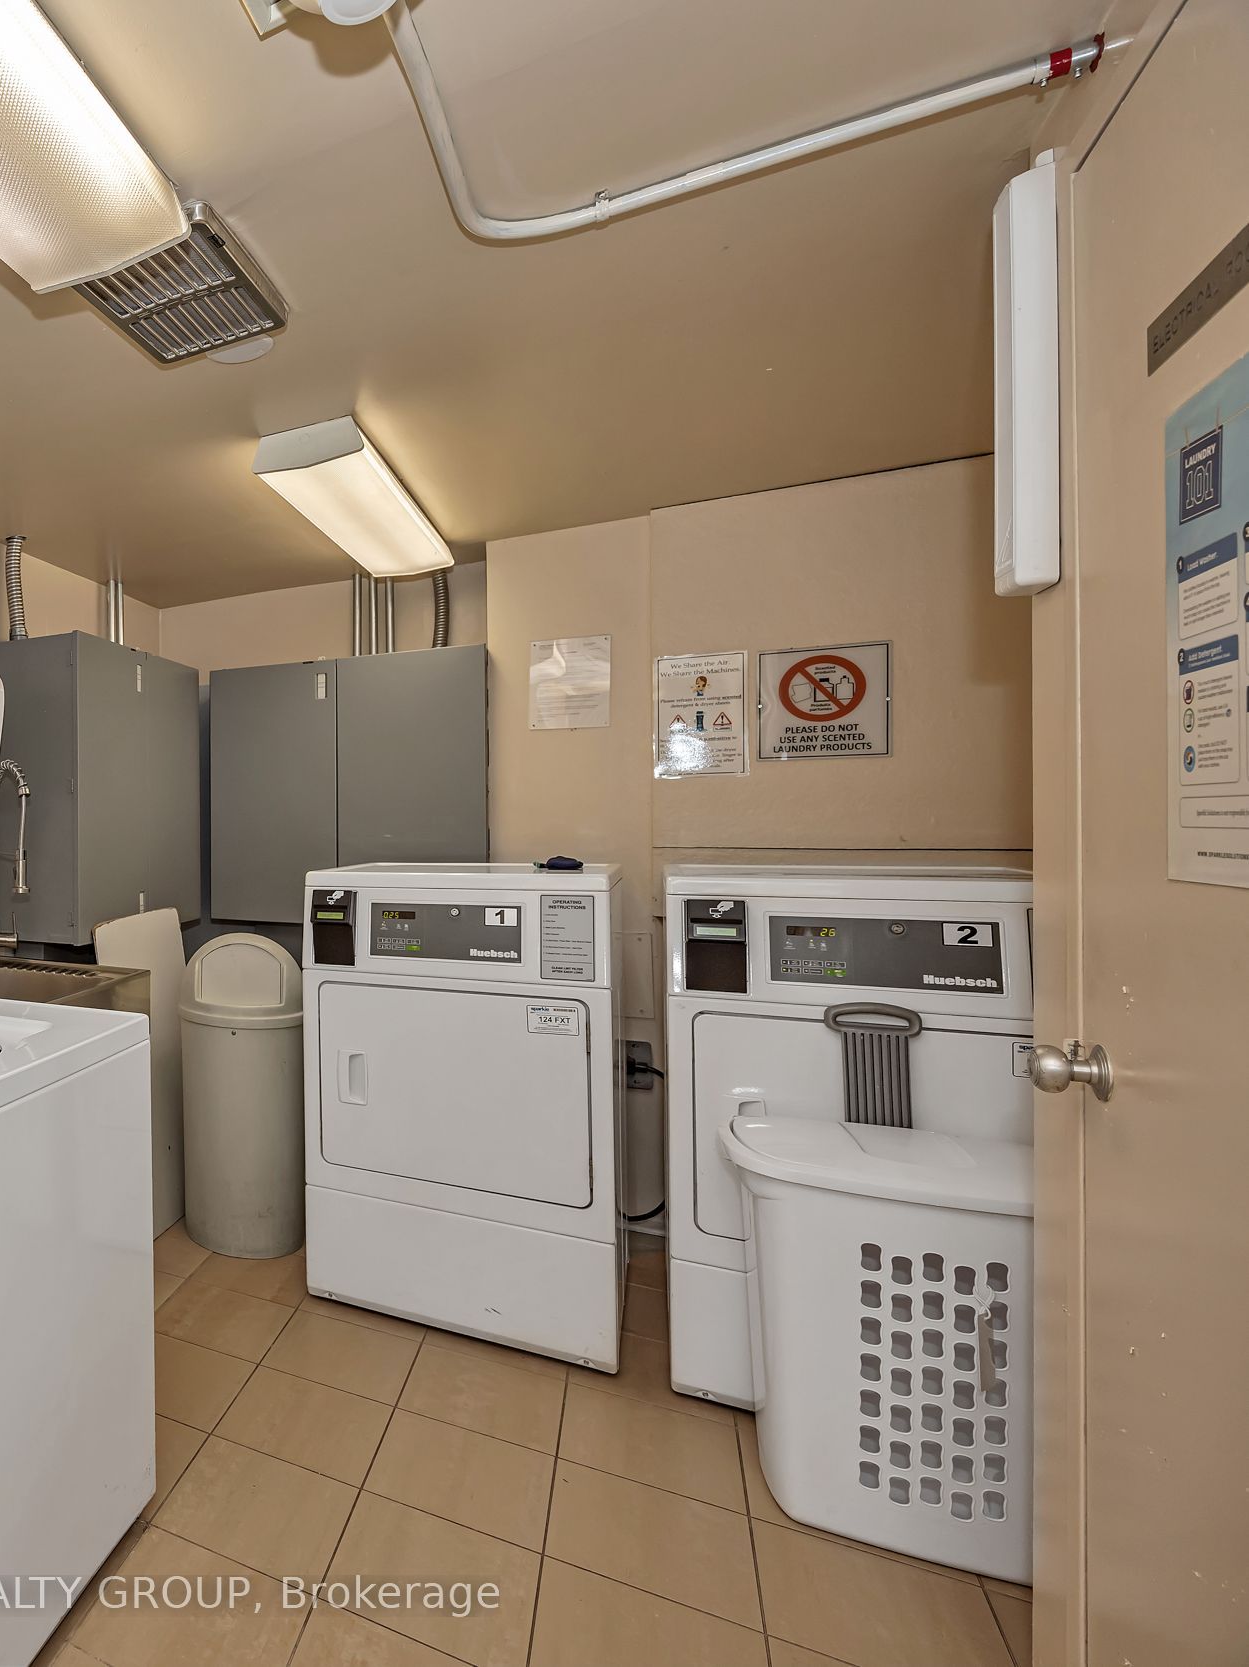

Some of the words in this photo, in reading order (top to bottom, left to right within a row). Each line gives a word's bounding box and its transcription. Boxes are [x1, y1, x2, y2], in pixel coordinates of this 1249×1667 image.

[1152, 282, 1219, 354] ELECTRICAL
[1185, 443, 1216, 469] LAUNDRY
[1186, 460, 1213, 509] 101
[785, 726, 818, 734] PLEASE
[838, 723, 859, 731] NOT
[780, 736, 796, 744] USE
[800, 735, 820, 743] ANY
[822, 733, 865, 742] SCENTED
[773, 744, 818, 753] LAUNDRY
[820, 742, 872, 751] PRODUCTS
[495, 910, 505, 924] 1
[820, 928, 836, 937] 26
[957, 925, 979, 944] 2
[469, 948, 518, 959] Huebsch
[922, 974, 998, 988] Huebsch
